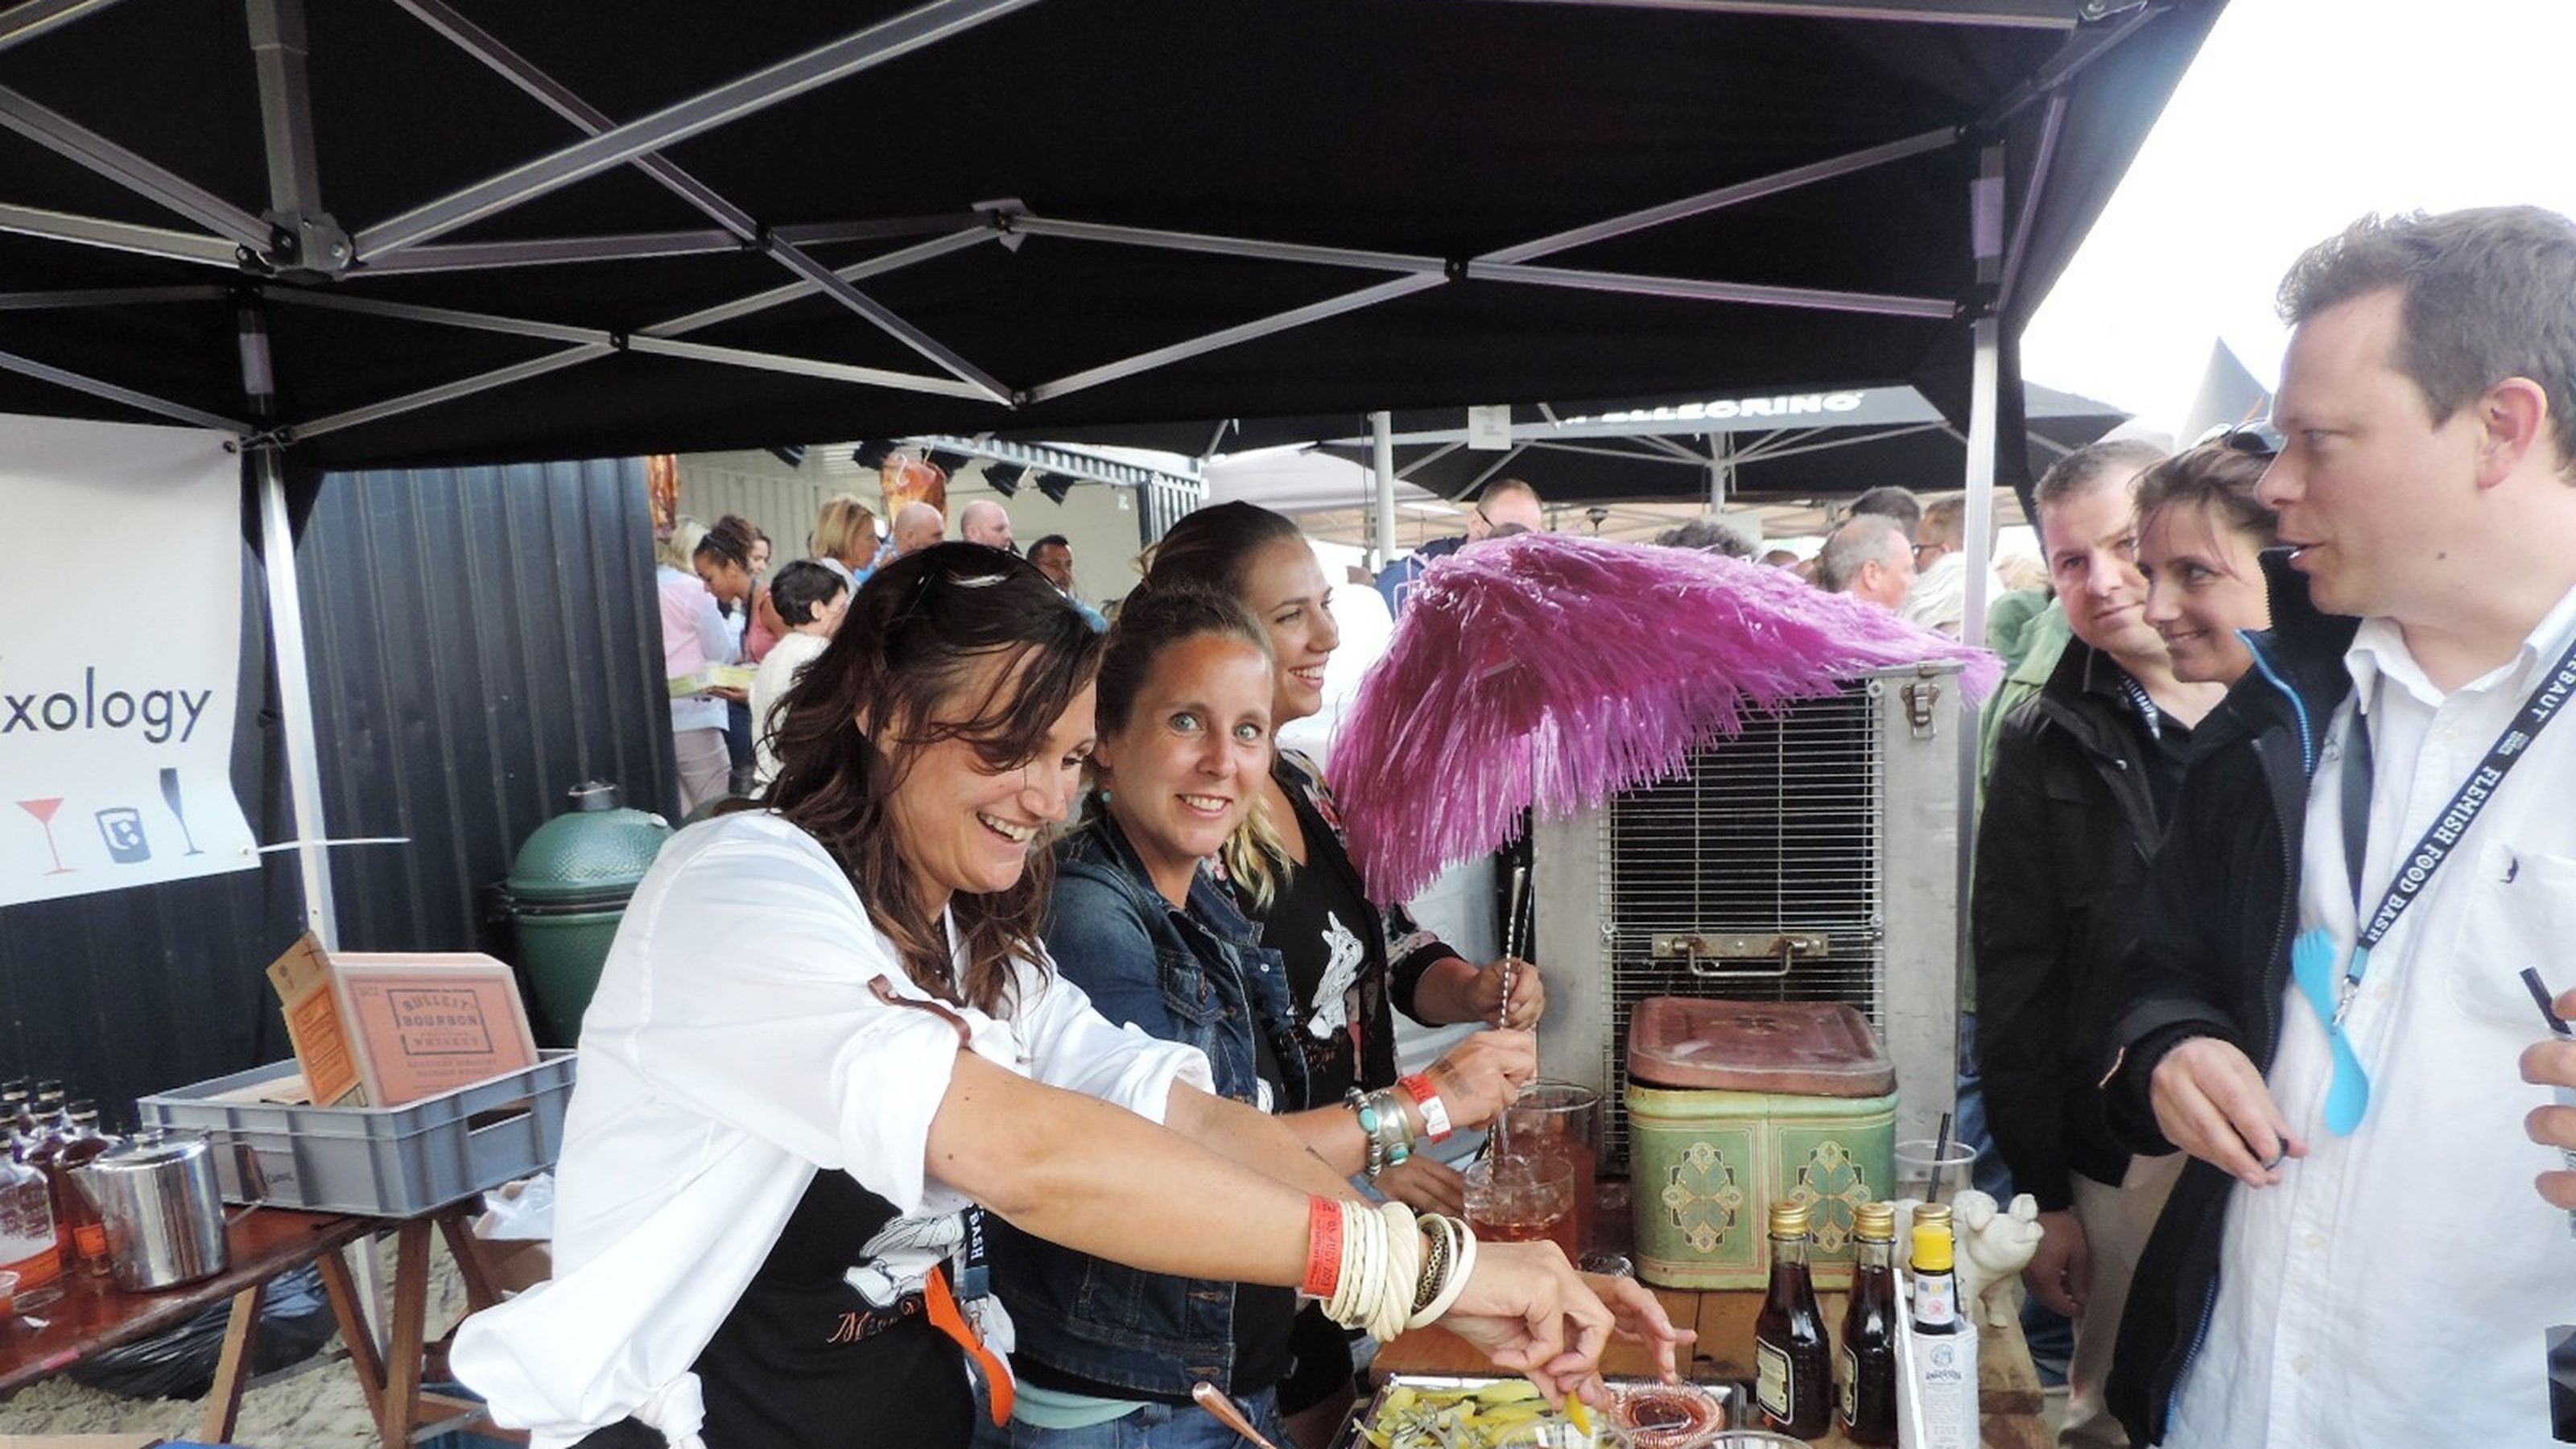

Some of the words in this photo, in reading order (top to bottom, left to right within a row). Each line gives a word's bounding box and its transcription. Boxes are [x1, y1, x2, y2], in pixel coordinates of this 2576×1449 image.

[2, 666, 213, 743] xology
[2433, 766, 2502, 845] FLEMISH
[2400, 844, 2445, 893] FOOD
[2367, 894, 2407, 941] BASH
[402, 1015, 478, 1026] BOURBON
[969, 1211, 983, 1261] BASH
